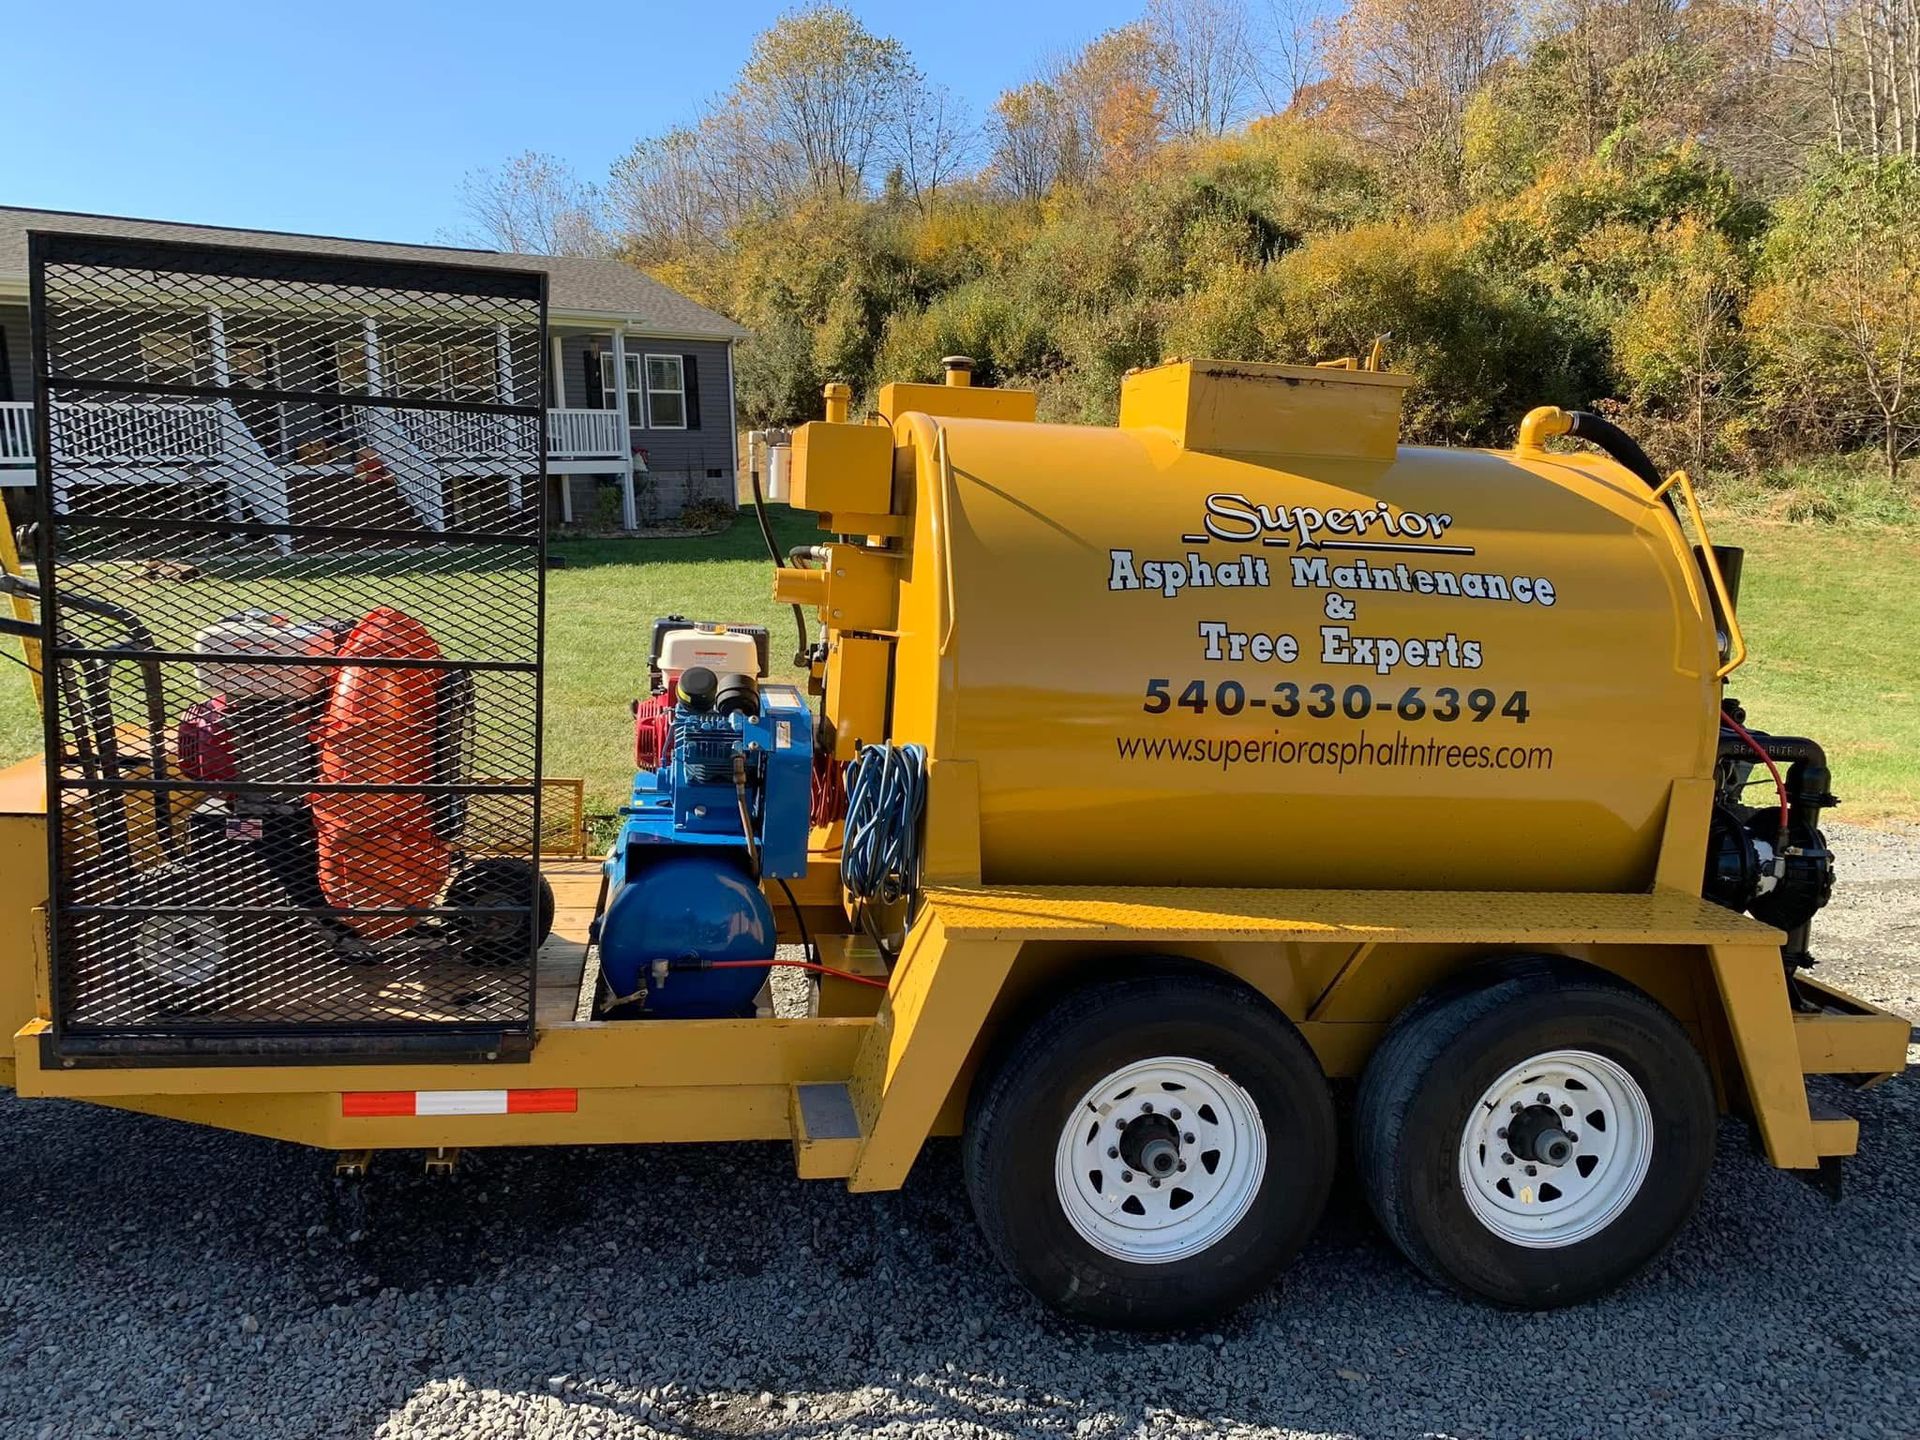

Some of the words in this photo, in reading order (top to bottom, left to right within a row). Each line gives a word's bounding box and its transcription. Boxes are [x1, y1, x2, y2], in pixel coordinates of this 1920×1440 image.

[1205, 493, 1453, 552] Superior
[1108, 549, 1270, 597] Asphalt
[1290, 556, 1557, 606] Maintenance
[1324, 592, 1356, 620] &
[1199, 621, 1298, 662] Tree
[1320, 625, 1483, 675] Experts
[1143, 679, 1530, 724] 540-330-6394
[1117, 729, 1553, 773] www.superiorasphaltntrees.com
